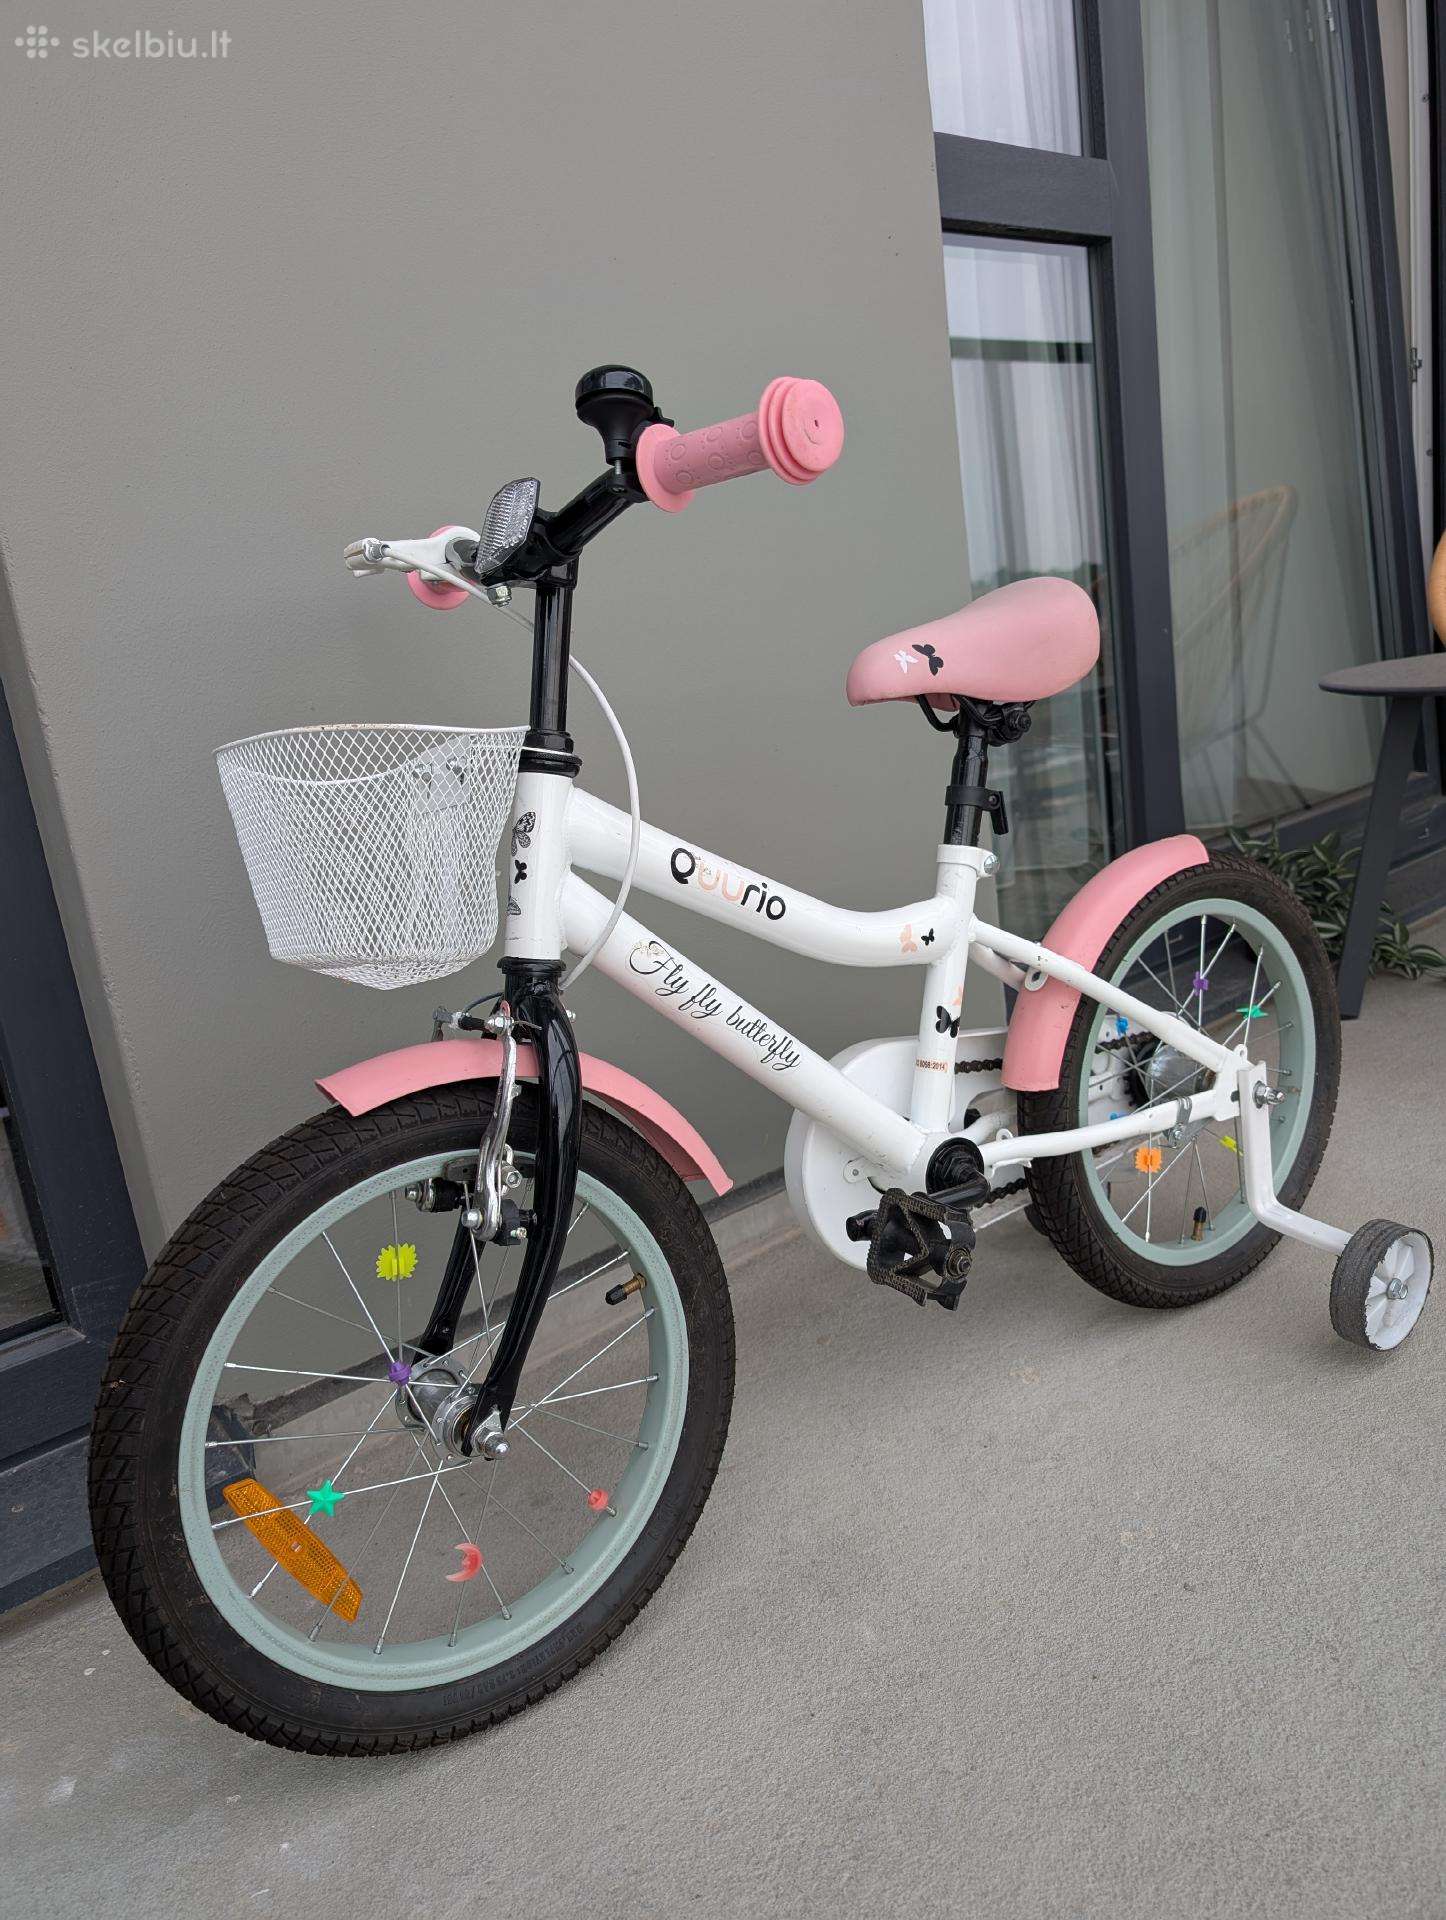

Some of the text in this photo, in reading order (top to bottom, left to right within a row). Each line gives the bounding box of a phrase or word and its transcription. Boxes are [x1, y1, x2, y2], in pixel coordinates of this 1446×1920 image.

[670, 847, 786, 920] Quurio
[629, 940, 801, 1071] Fly fly butterfly
